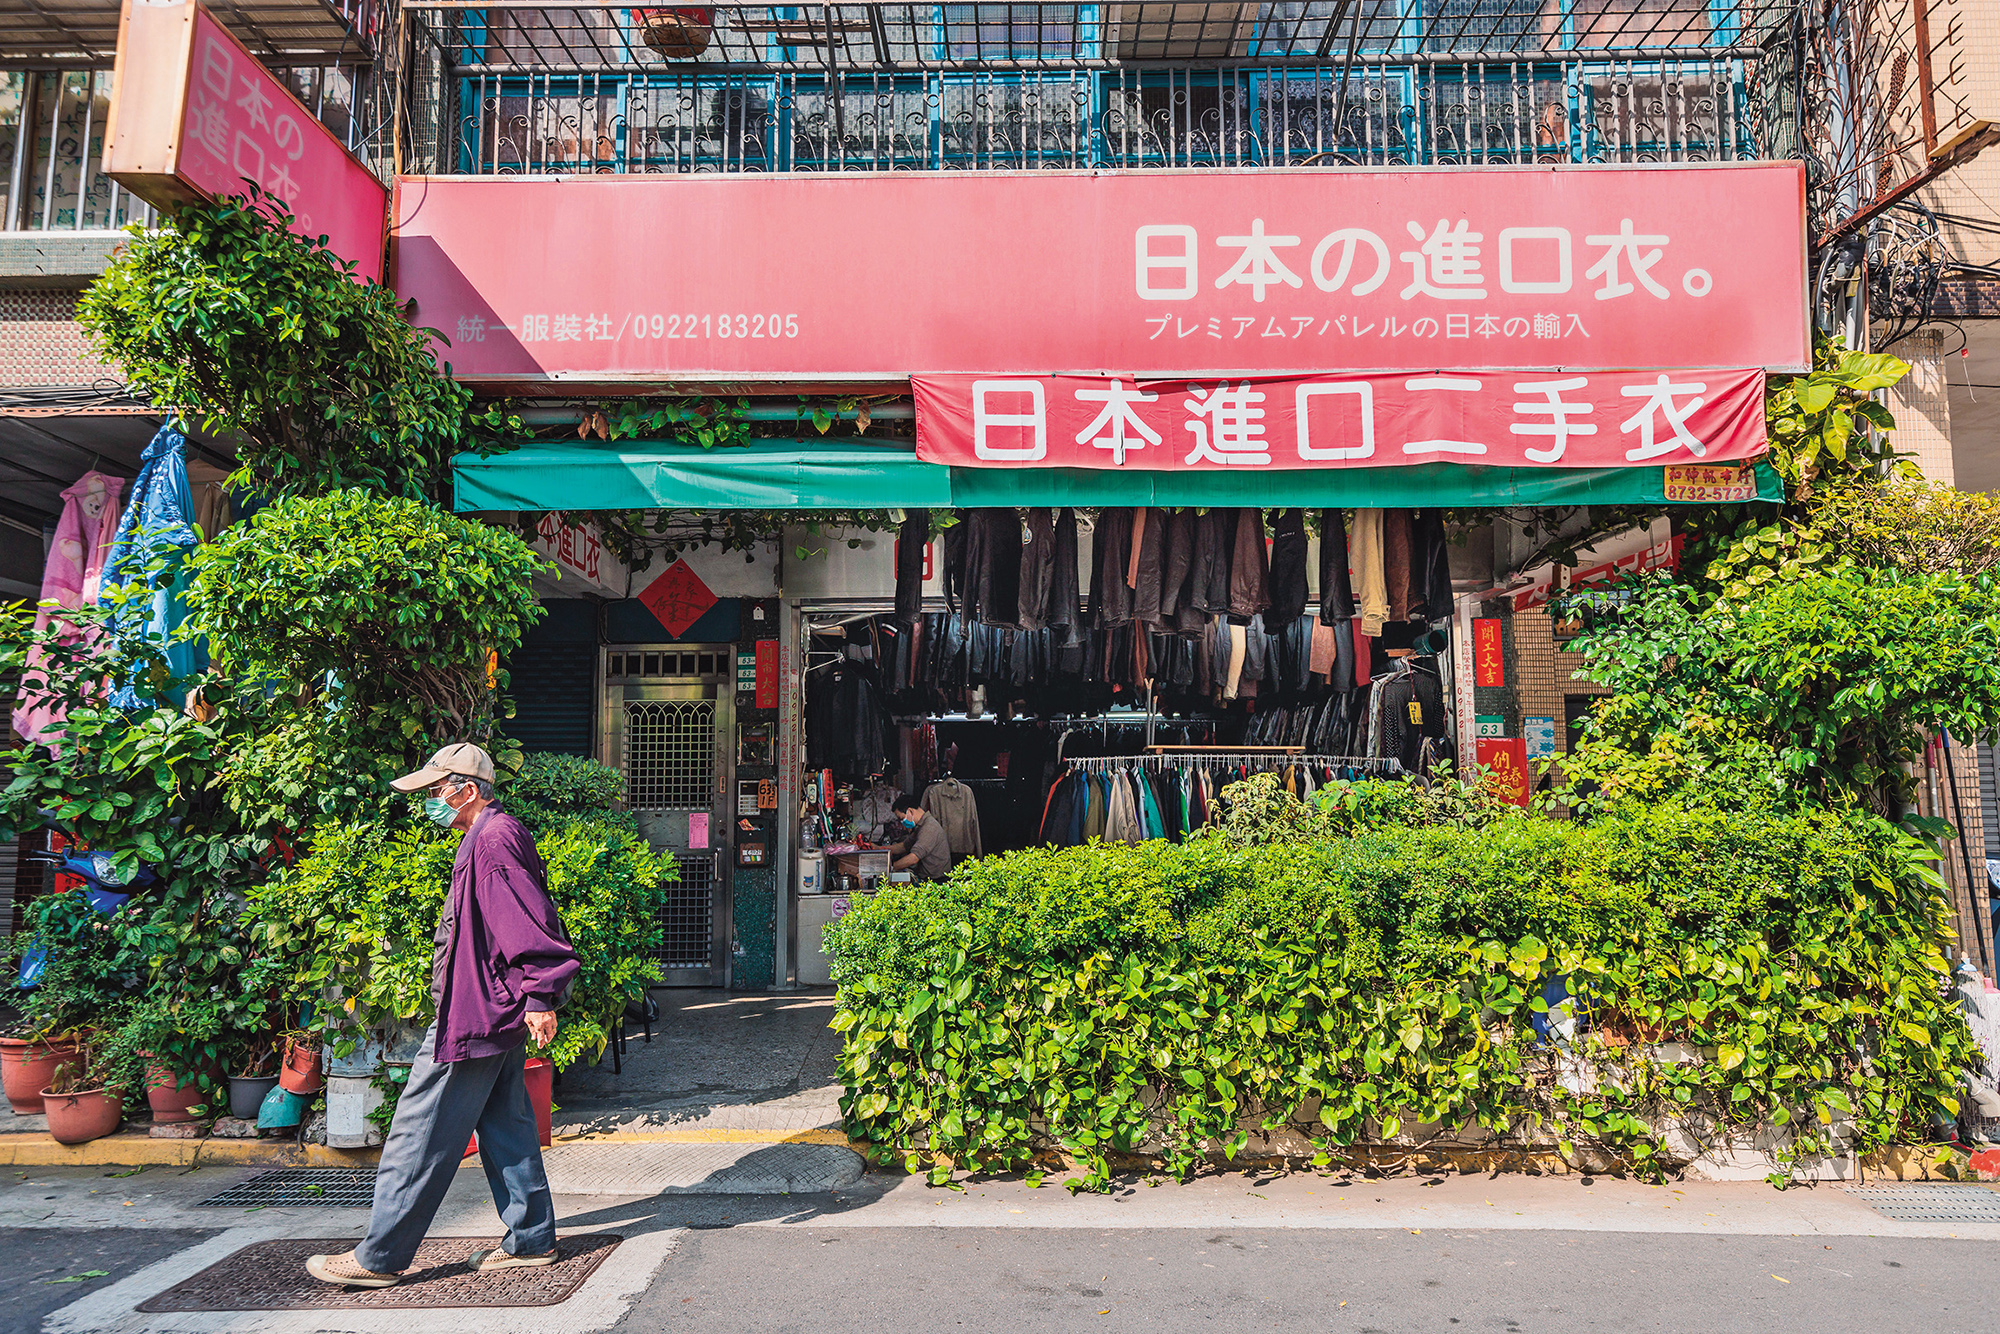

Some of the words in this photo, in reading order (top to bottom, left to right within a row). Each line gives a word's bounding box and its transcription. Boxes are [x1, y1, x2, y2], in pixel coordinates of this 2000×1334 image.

[202, 36, 304, 161] 日本の
[1135, 218, 1713, 302] 日本の進口衣。
[456, 312, 799, 342] 統一服裝社/0922183205
[1145, 313, 1591, 340] プレミアムアパレルの日本の輸入
[972, 374, 1709, 466] 日本進口二手衣
[1668, 484, 1753, 500] 8732-5727
[761, 648, 774, 705] 開市大吉
[1480, 625, 1499, 684] 開工大吉
[1480, 724, 1498, 735] 63
